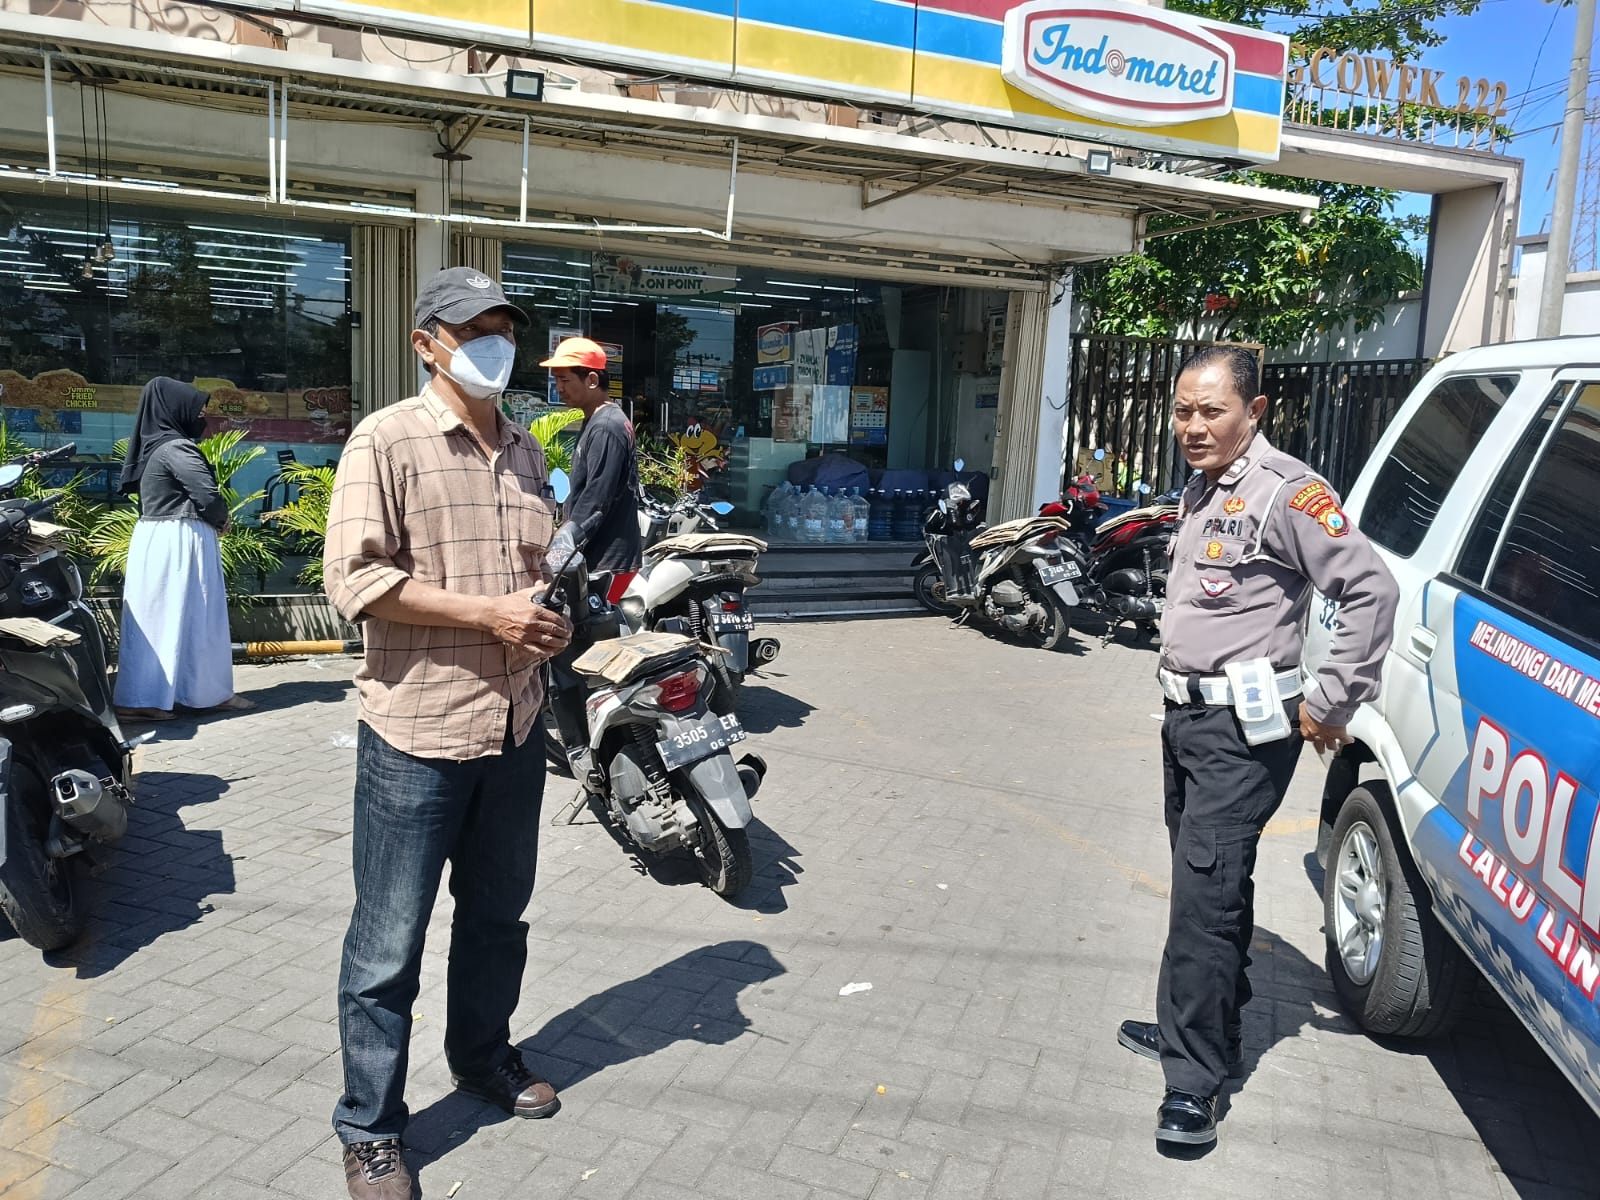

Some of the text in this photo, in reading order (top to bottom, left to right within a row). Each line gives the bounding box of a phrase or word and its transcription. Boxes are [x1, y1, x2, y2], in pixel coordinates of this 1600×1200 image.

[1034, 23, 1218, 96] Indomaret
[1454, 76, 1508, 117] 222
[646, 278, 704, 290] ON POINT
[65, 399, 98, 408] CHICKEN
[71, 392, 93, 400] FRIED
[1470, 620, 1552, 682] MELINDUNGI
[1543, 659, 1583, 700] DAN
[673, 725, 708, 749] 3505
[718, 713, 739, 731] ER
[1459, 831, 1537, 921] LALU
